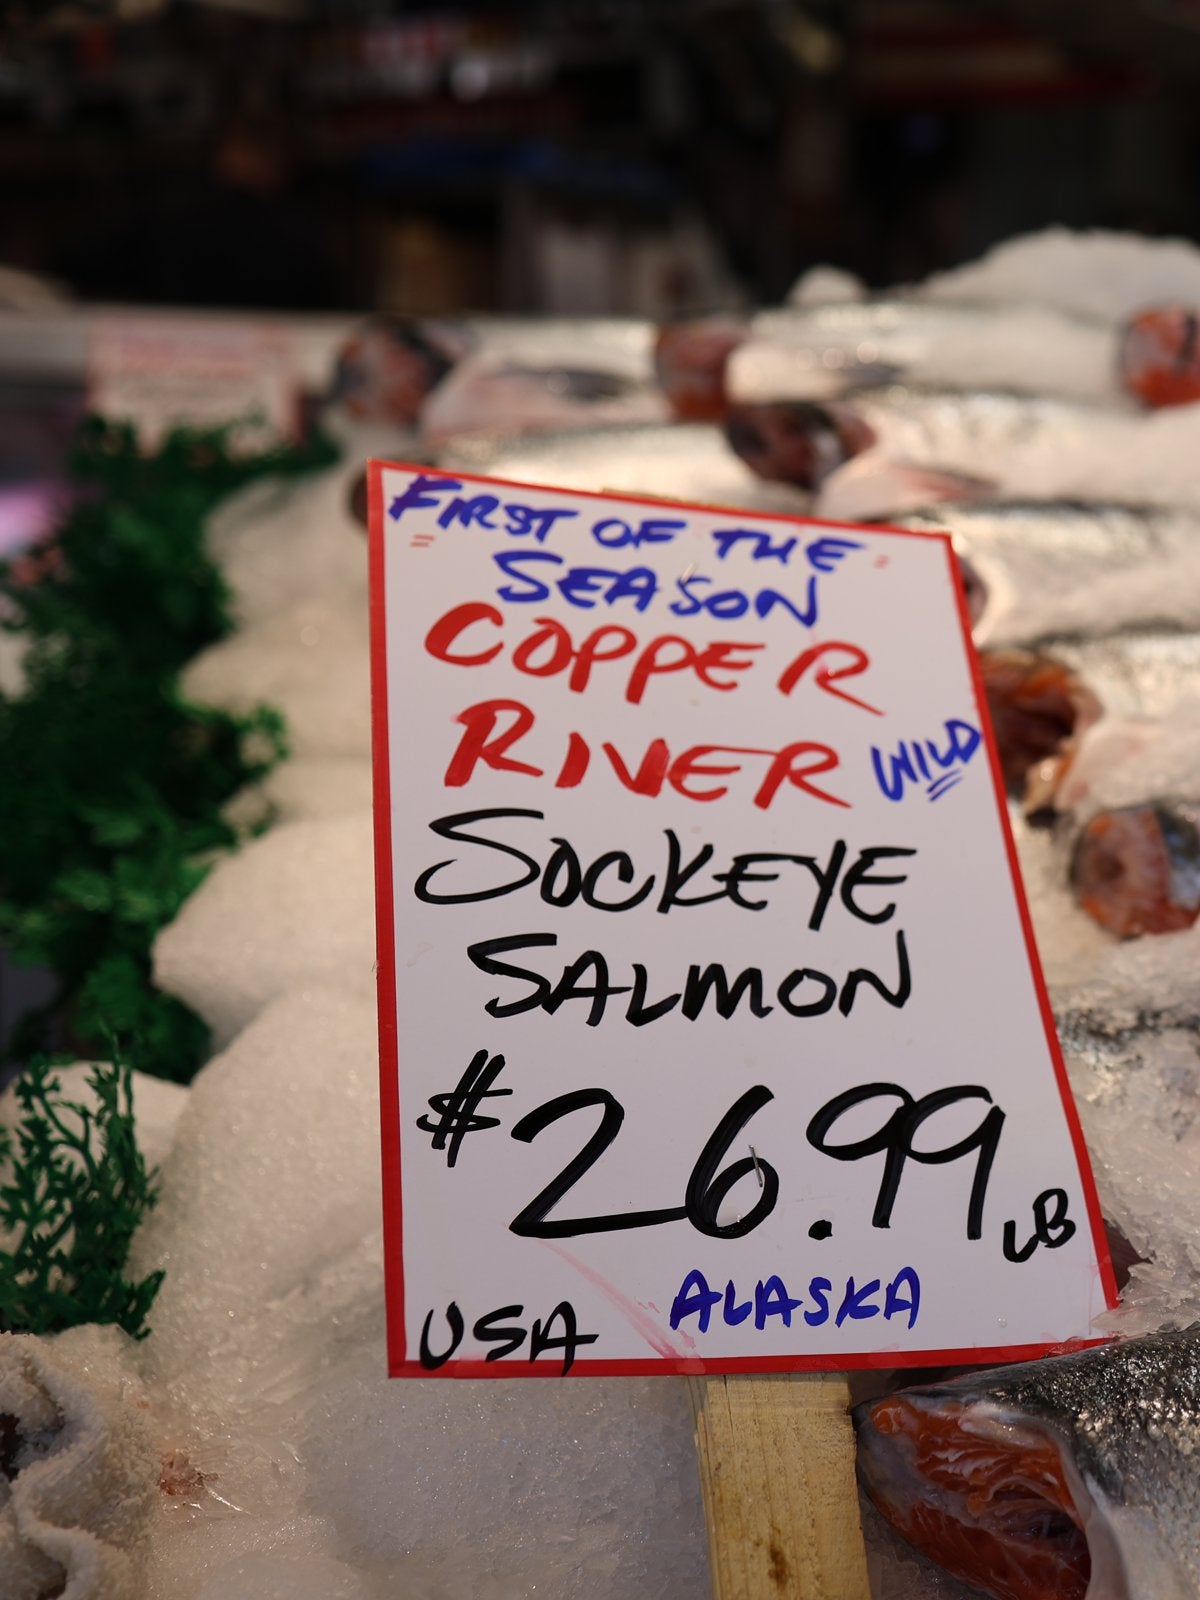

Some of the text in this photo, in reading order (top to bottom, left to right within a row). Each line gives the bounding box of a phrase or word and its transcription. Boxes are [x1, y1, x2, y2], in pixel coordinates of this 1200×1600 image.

[387, 473, 868, 573] FIRST OF THE
[492, 549, 819, 628] SEASON
[424, 601, 885, 716] COPPER
[444, 698, 983, 810] RIVER WILD
[414, 807, 917, 930] SOCKEYE
[467, 929, 913, 1028] SALMON
[416, 1049, 1077, 1263] $26.99 LB
[418, 1300, 600, 1377] USA
[669, 1266, 921, 1332] ALASKA
